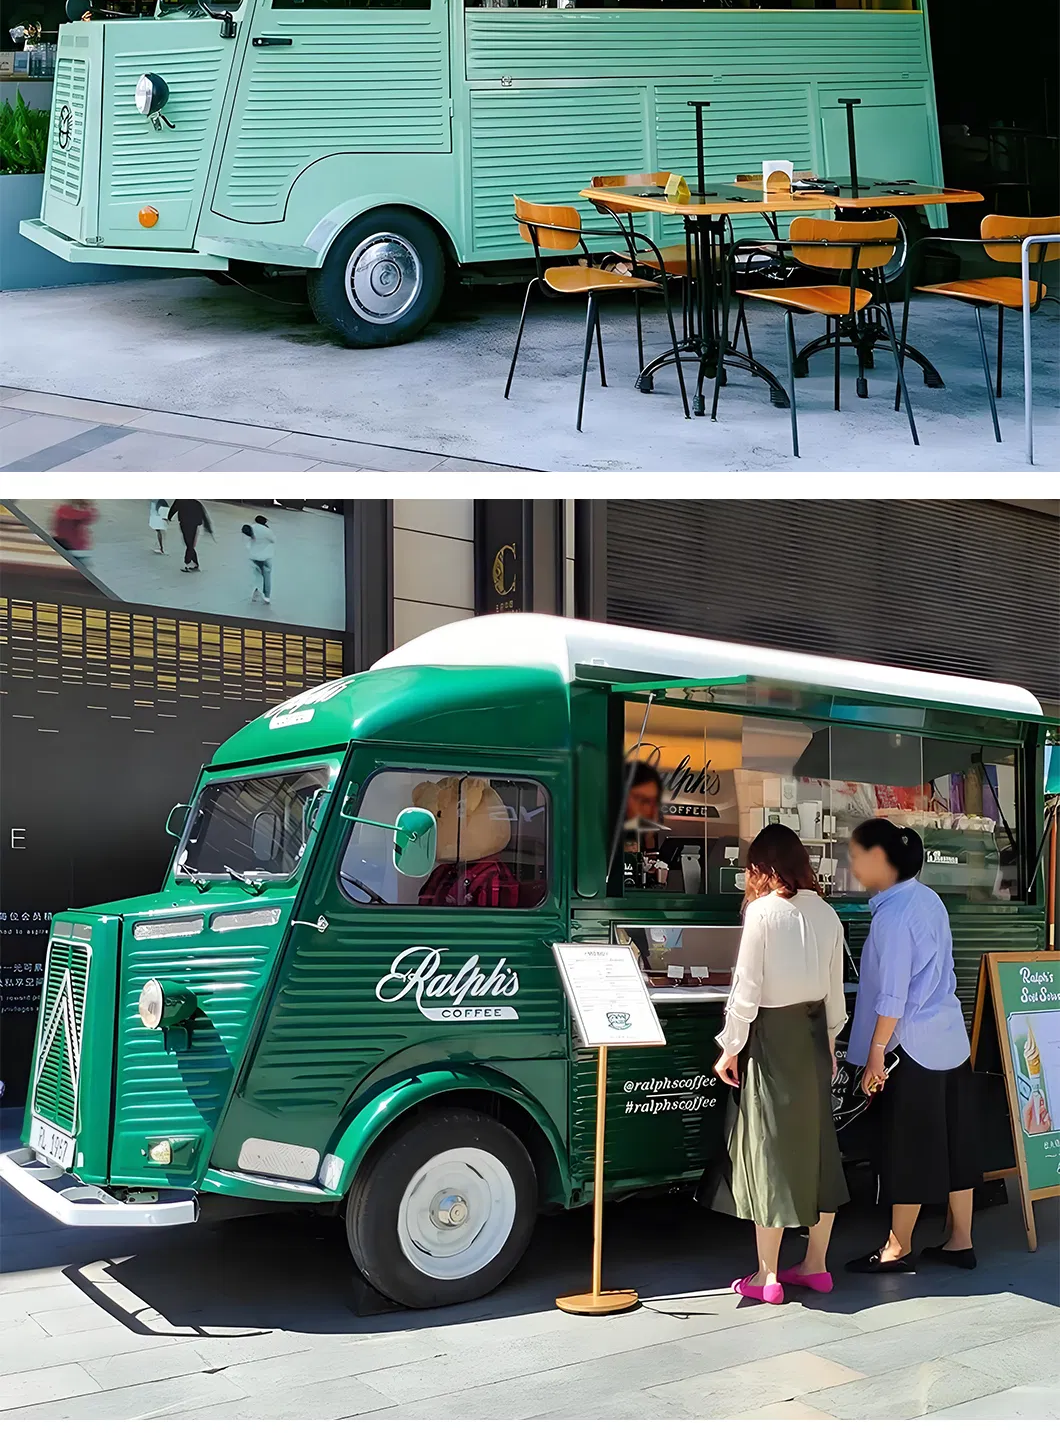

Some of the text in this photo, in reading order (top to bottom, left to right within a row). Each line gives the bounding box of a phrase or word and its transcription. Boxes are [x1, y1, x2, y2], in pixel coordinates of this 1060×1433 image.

[11, 827, 27, 850] E
[375, 945, 520, 1006] Ralph's
[441, 1008, 502, 1018] COFFEE
[623, 1074, 717, 1093] @ralphscoffee
[624, 1095, 717, 1115] #ralphscoffee
